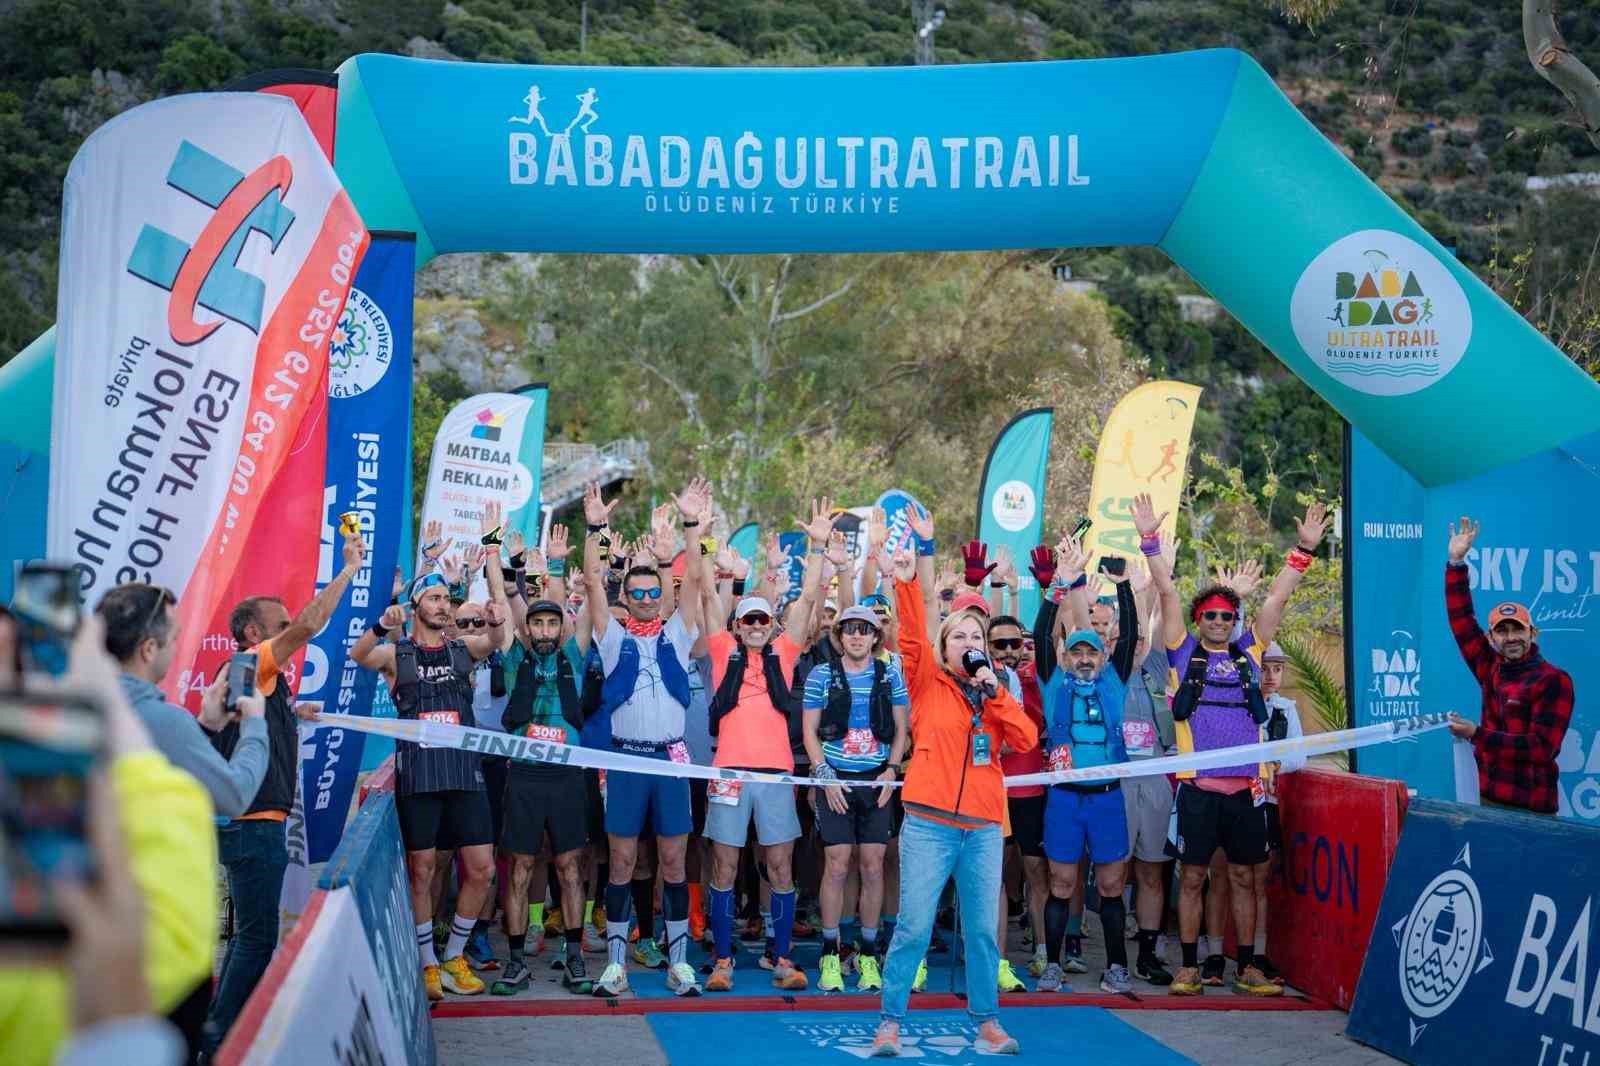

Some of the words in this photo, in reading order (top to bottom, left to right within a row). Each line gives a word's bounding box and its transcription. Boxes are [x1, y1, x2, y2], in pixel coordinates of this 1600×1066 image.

[645, 192, 774, 214] ÖLÜDENİZ
[790, 192, 901, 214] TÜRKİYE
[1336, 271, 1424, 300] BABA
[446, 442, 512, 466] MATBAA
[442, 468, 509, 492] REKLAM
[1364, 522, 1383, 538] RUN
[1385, 523, 1423, 539] LYCIAN
[1464, 547, 1530, 592] SKY
[1542, 549, 1578, 594] IS
[461, 731, 573, 765] FINISH
